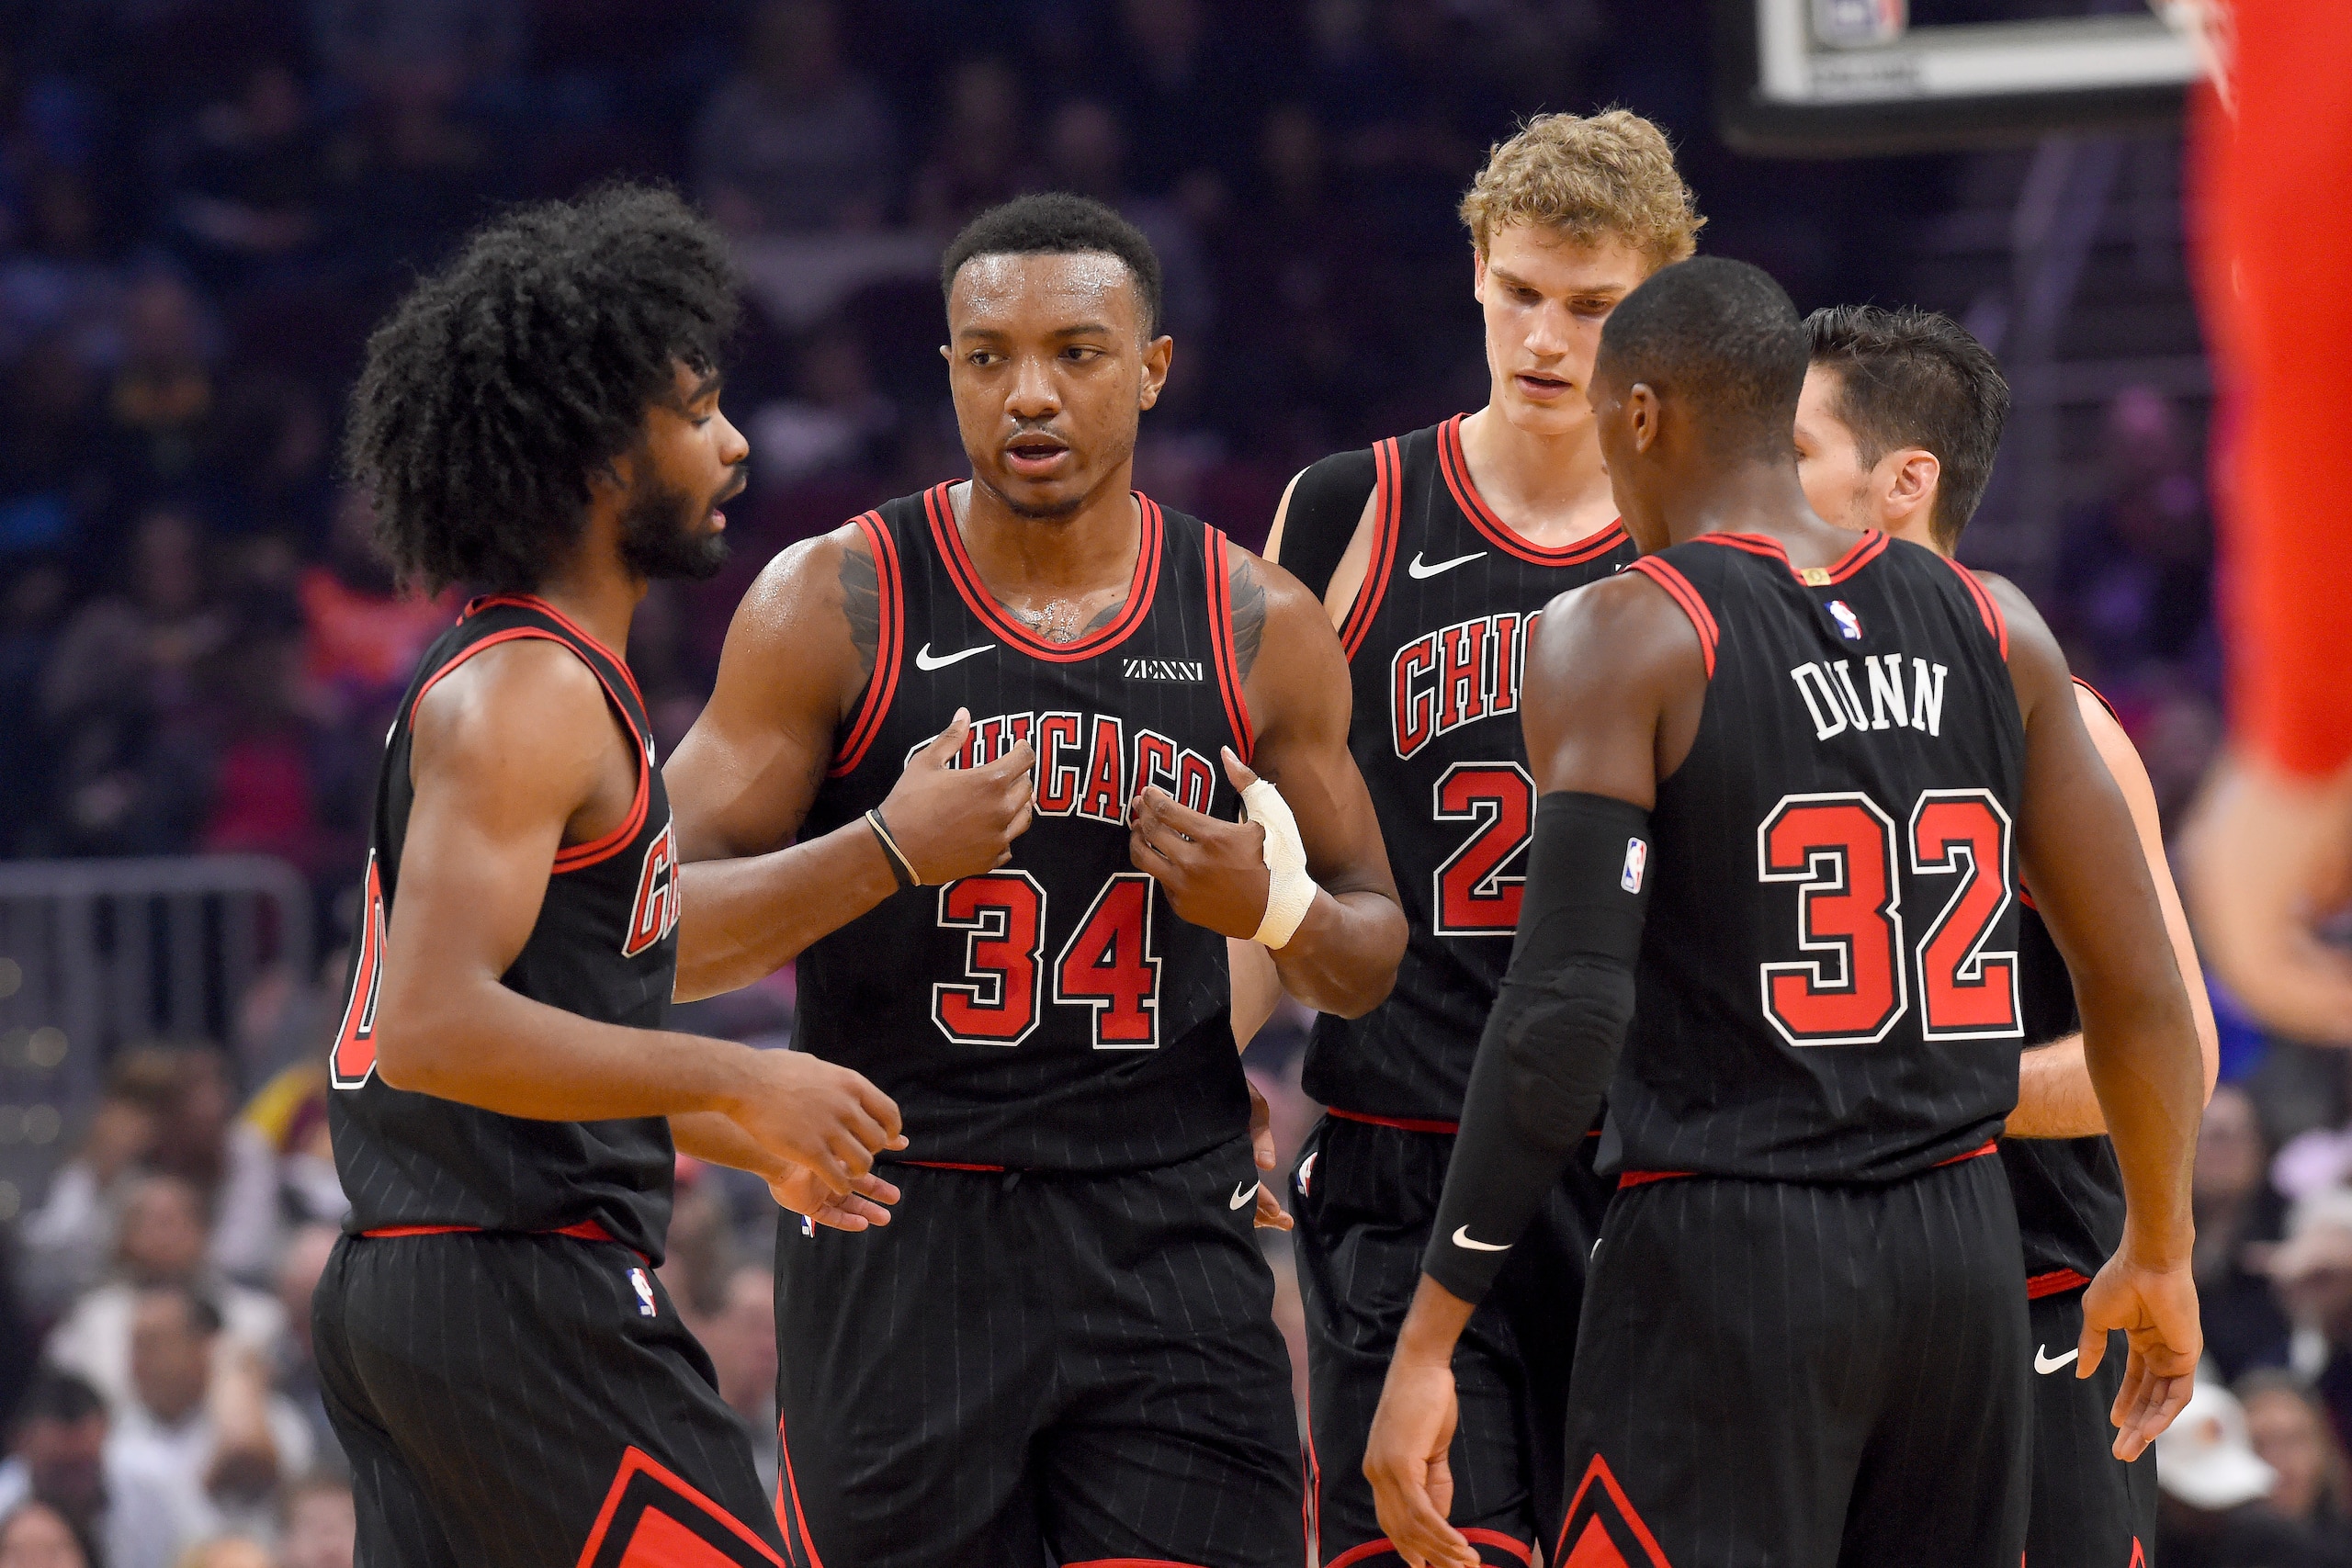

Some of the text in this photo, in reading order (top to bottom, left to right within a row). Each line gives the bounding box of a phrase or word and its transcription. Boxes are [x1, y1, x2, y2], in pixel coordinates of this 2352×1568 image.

[1123, 659, 1204, 681] ZENNI
[1391, 610, 1544, 761] CHI
[1790, 653, 1948, 741] DUNN
[1433, 761, 1538, 936] 2
[1758, 788, 2025, 1047] 32
[932, 869, 1162, 1051] 34
